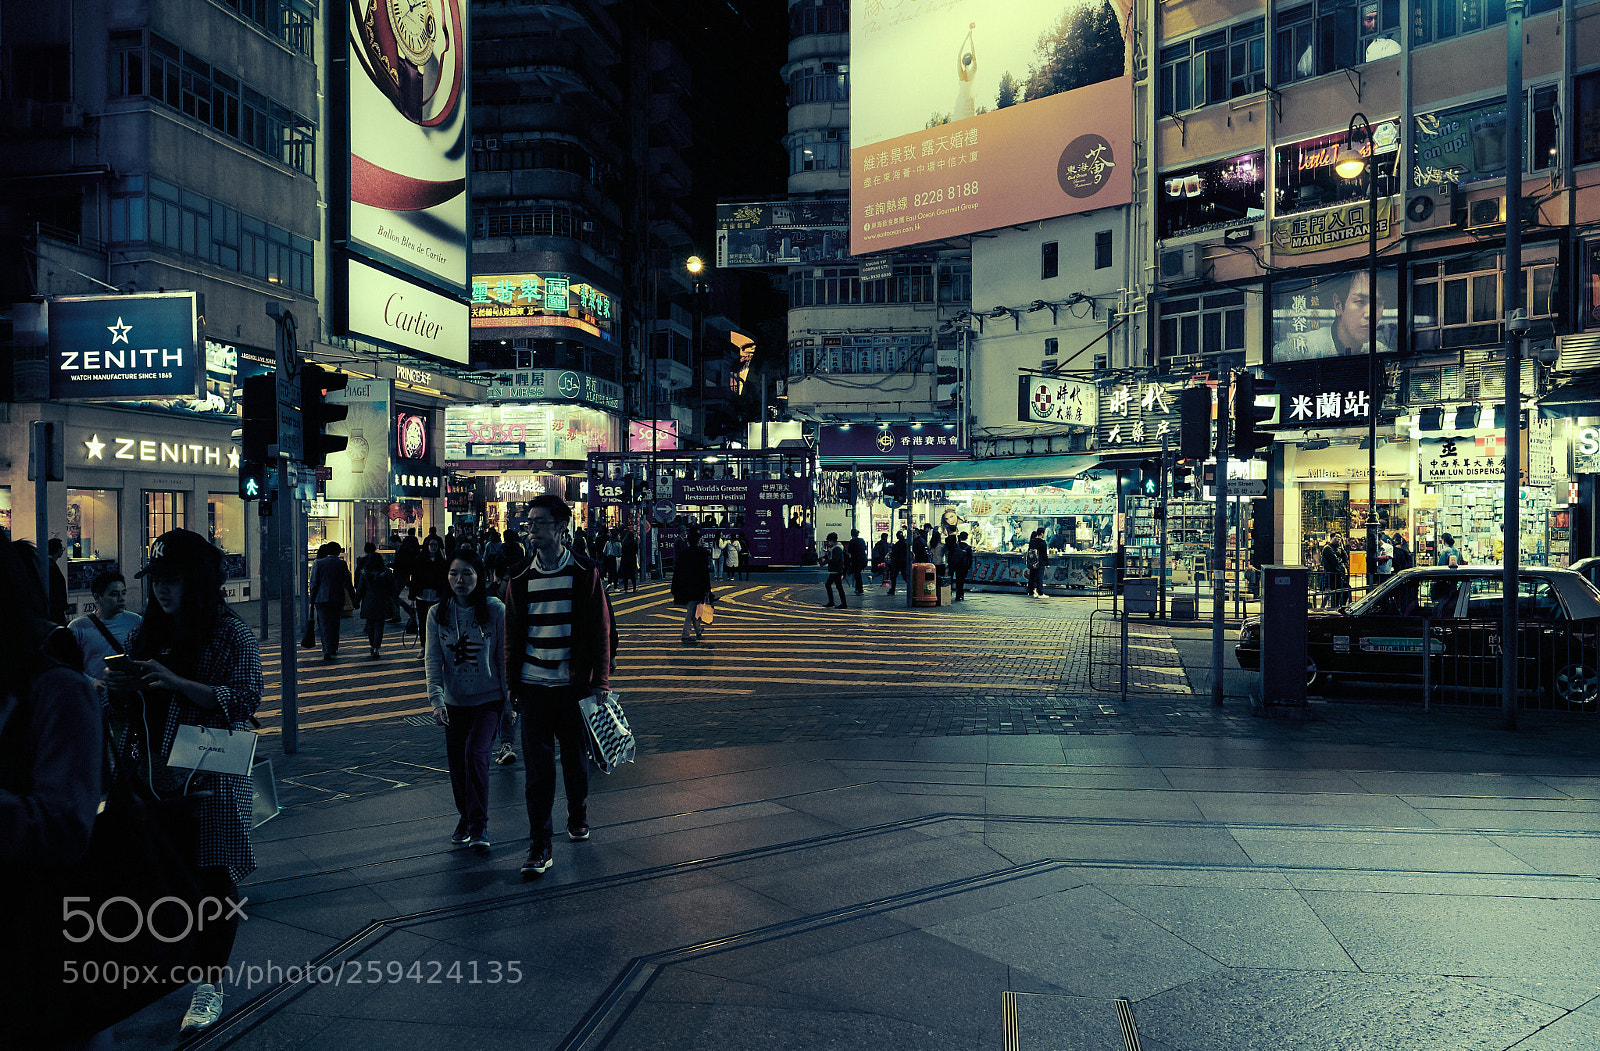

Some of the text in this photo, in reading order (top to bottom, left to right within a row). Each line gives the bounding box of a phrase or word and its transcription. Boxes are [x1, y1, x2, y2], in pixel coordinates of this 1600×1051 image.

[864, 127, 978, 173] 維港景致 露天婚禮
[1422, 132, 1468, 160] on up!
[1298, 147, 1330, 171] Little
[864, 180, 979, 217] 查詢熱線 8228 8188
[905, 214, 917, 222] East
[917, 211, 936, 220] Ocean
[936, 206, 960, 216] Gourmet
[960, 202, 979, 213] Group
[1292, 207, 1365, 236] 正門入口
[791, 231, 806, 241] 70s
[1291, 218, 1387, 248] MAIN ENTRANE
[377, 225, 447, 265] Ballon Bleu de Cartier
[384, 292, 443, 341] Cartier
[60, 348, 183, 371] ZENITH
[71, 371, 173, 382] WATCH MANUFACTURE SINCE 1865
[396, 365, 421, 383] PRINCE
[344, 384, 372, 398] PIAGET
[509, 387, 545, 398] MESS
[1109, 385, 1170, 418] 時代
[1289, 390, 1370, 421] 米蘭站
[900, 435, 958, 446] 香港賽馬會
[115, 438, 220, 465] ZENITH
[1308, 468, 1339, 478] Milan
[1466, 467, 1506, 475] DISPENSA
[495, 479, 546, 498] Folli Follie
[598, 483, 624, 497] tas
[685, 493, 746, 501] Restaurant Festival
[694, 484, 720, 492] World's
[84, 603, 98, 613] ZEN
[1488, 633, 1501, 644] 的
[1488, 644, 1504, 655] TA
[198, 745, 226, 754] CHANEL
